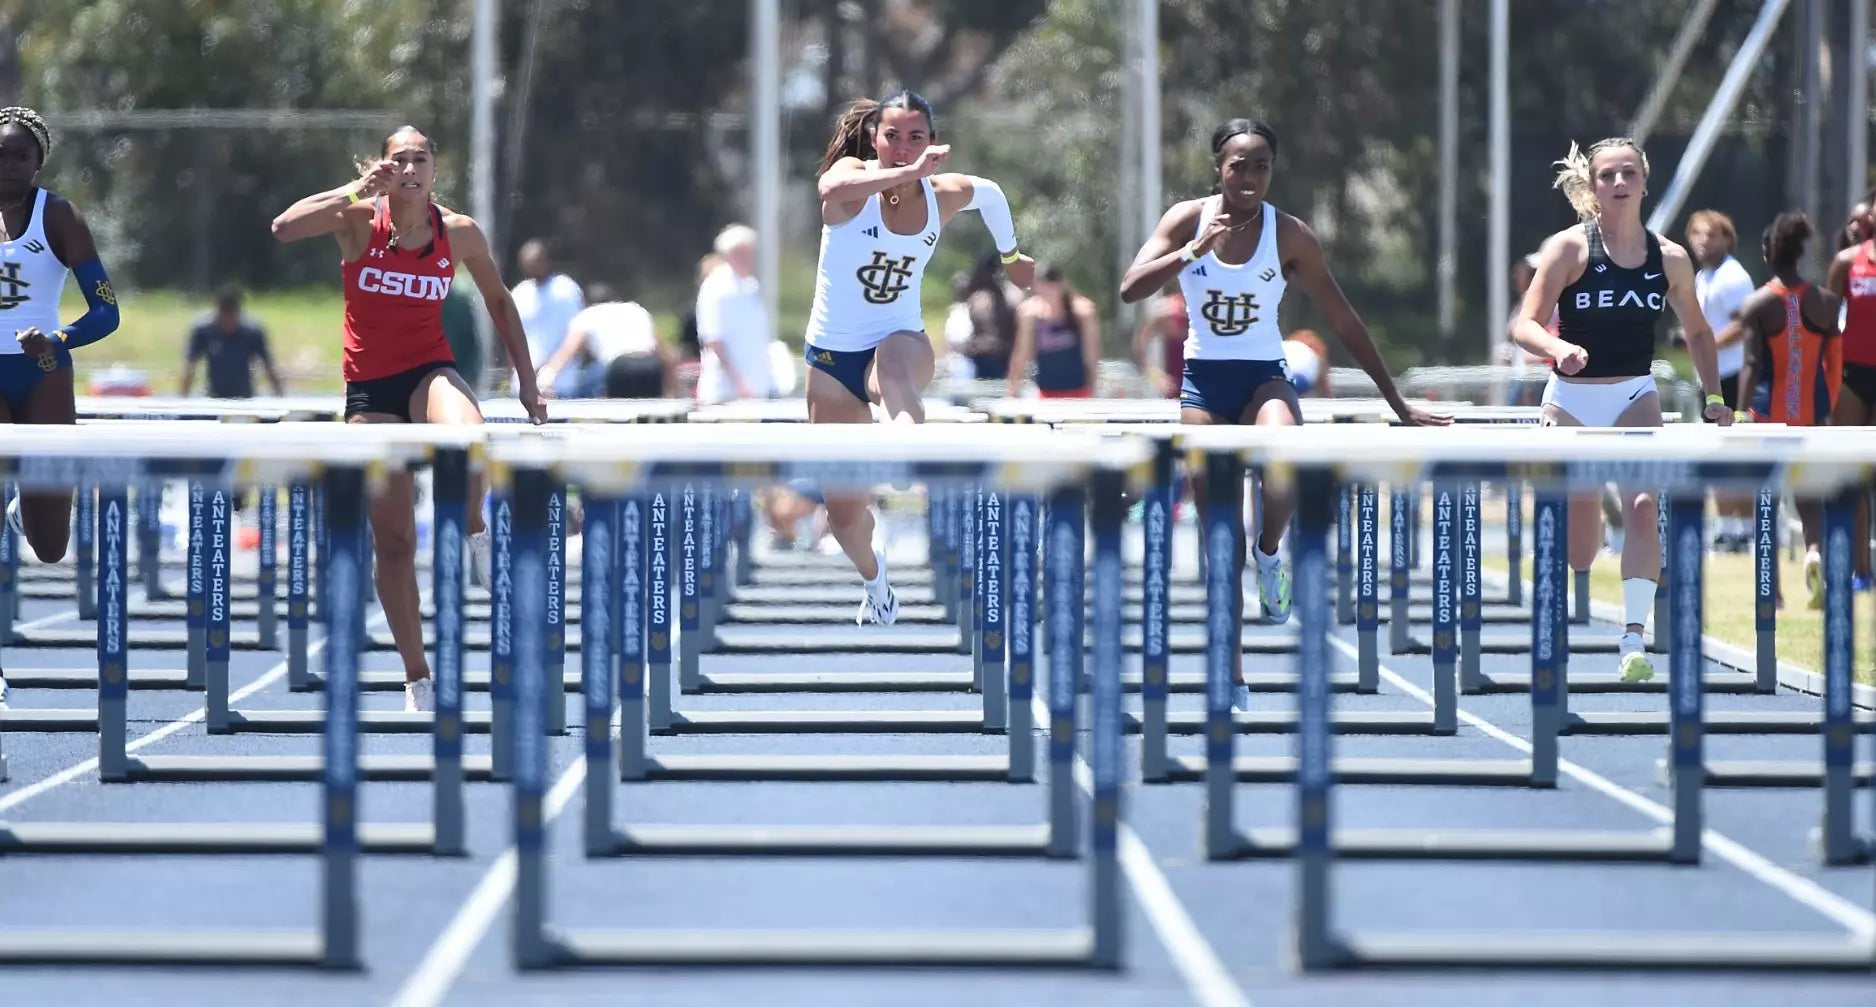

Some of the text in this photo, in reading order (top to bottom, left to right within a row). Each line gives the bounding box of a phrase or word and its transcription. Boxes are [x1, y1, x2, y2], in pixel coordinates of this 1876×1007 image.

[358, 266, 452, 301] CSUN
[1575, 289, 1666, 313] BEAC
[105, 499, 121, 654] ANTEATERS
[212, 490, 226, 622] ANTEATERS
[496, 500, 512, 656] ANTEATERS
[548, 493, 561, 624] ANTEATERS
[624, 500, 640, 656] ANTEATERS
[653, 493, 666, 624] ANTEATERS
[683, 481, 696, 596] ANTEATERS
[987, 491, 1000, 623] ANTEATERS
[1013, 501, 1030, 655] ANTEATERS
[1148, 500, 1165, 656] ANTEATERS
[1437, 492, 1452, 623] ANTEATERS
[1464, 481, 1476, 596] ANTEATERS
